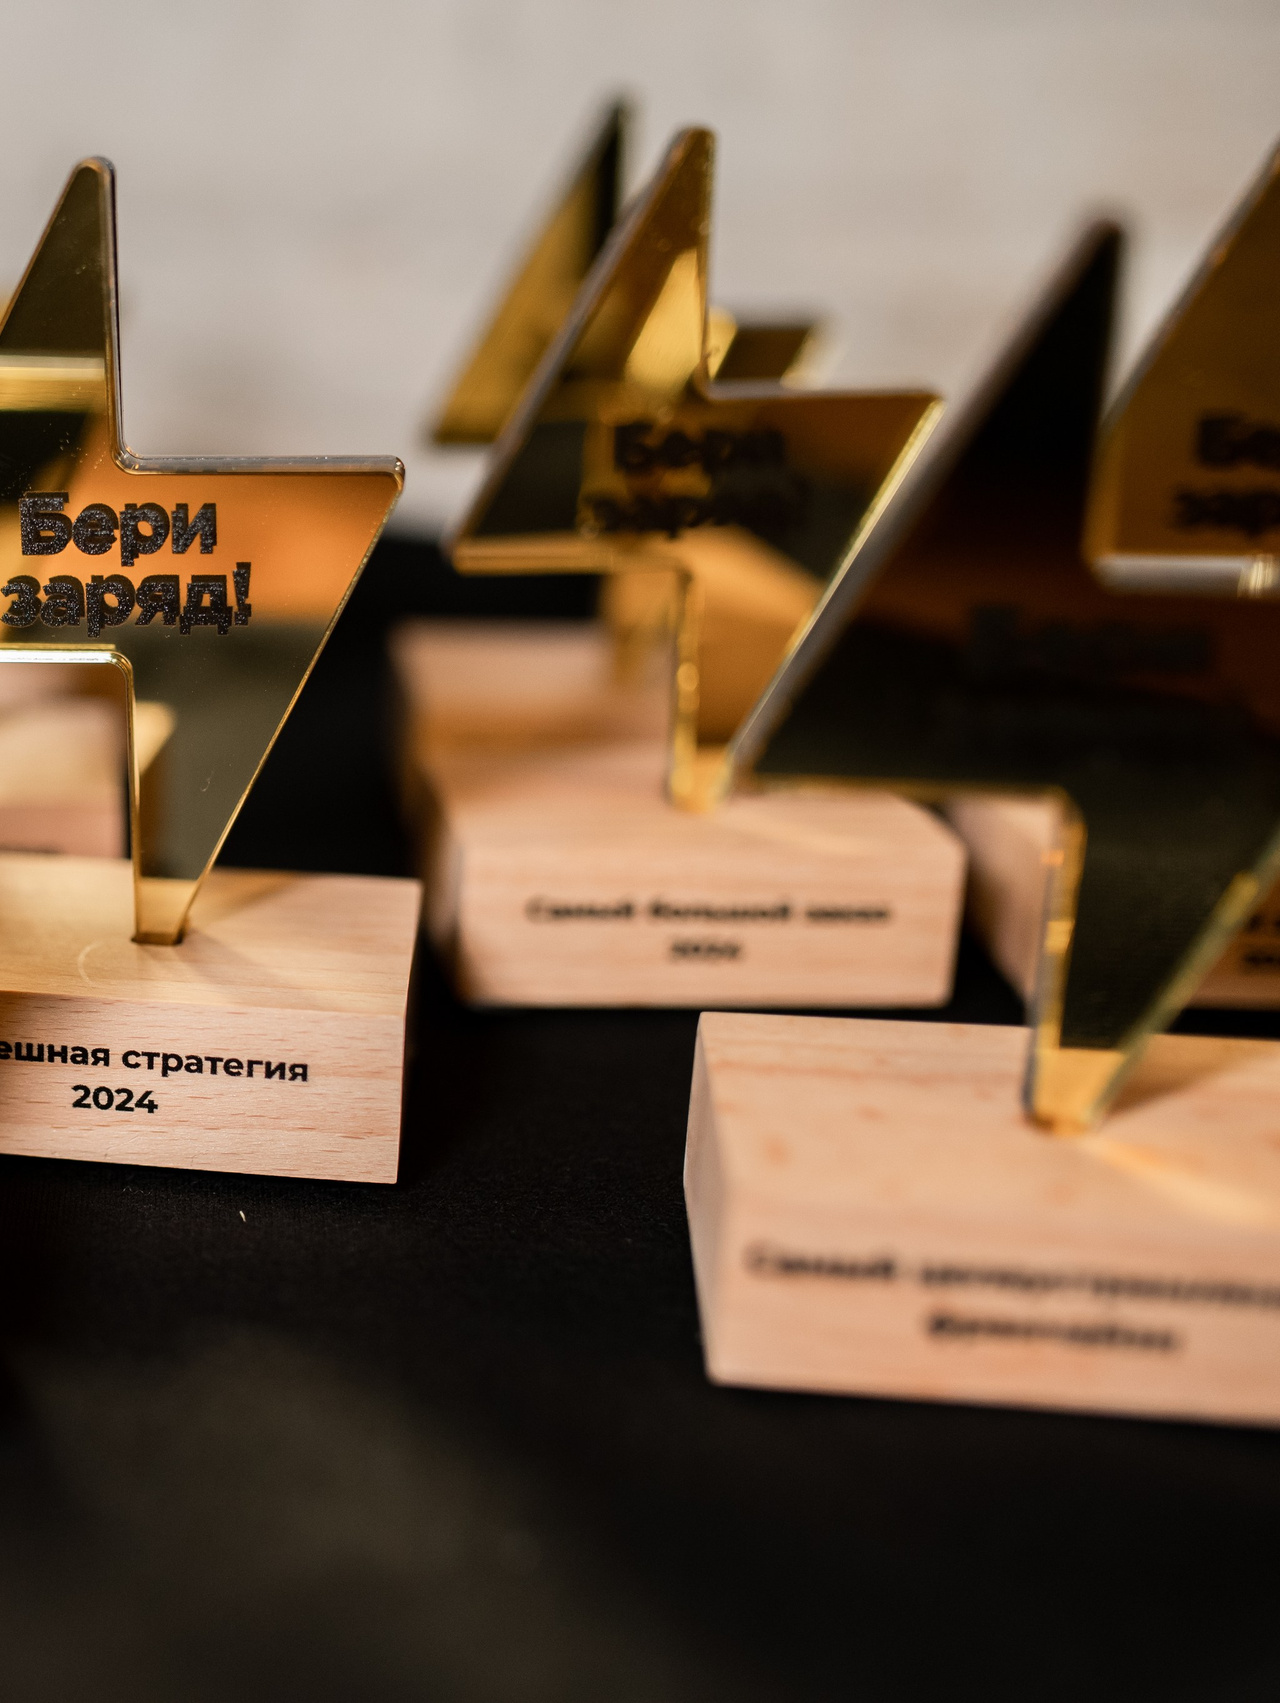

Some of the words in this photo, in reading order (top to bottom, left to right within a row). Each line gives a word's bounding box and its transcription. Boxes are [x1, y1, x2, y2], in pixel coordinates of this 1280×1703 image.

[18, 491, 218, 567] Бери
[0, 562, 253, 638] заряд!
[121, 1048, 309, 1082] стратегия
[71, 1084, 159, 1114] 2024
